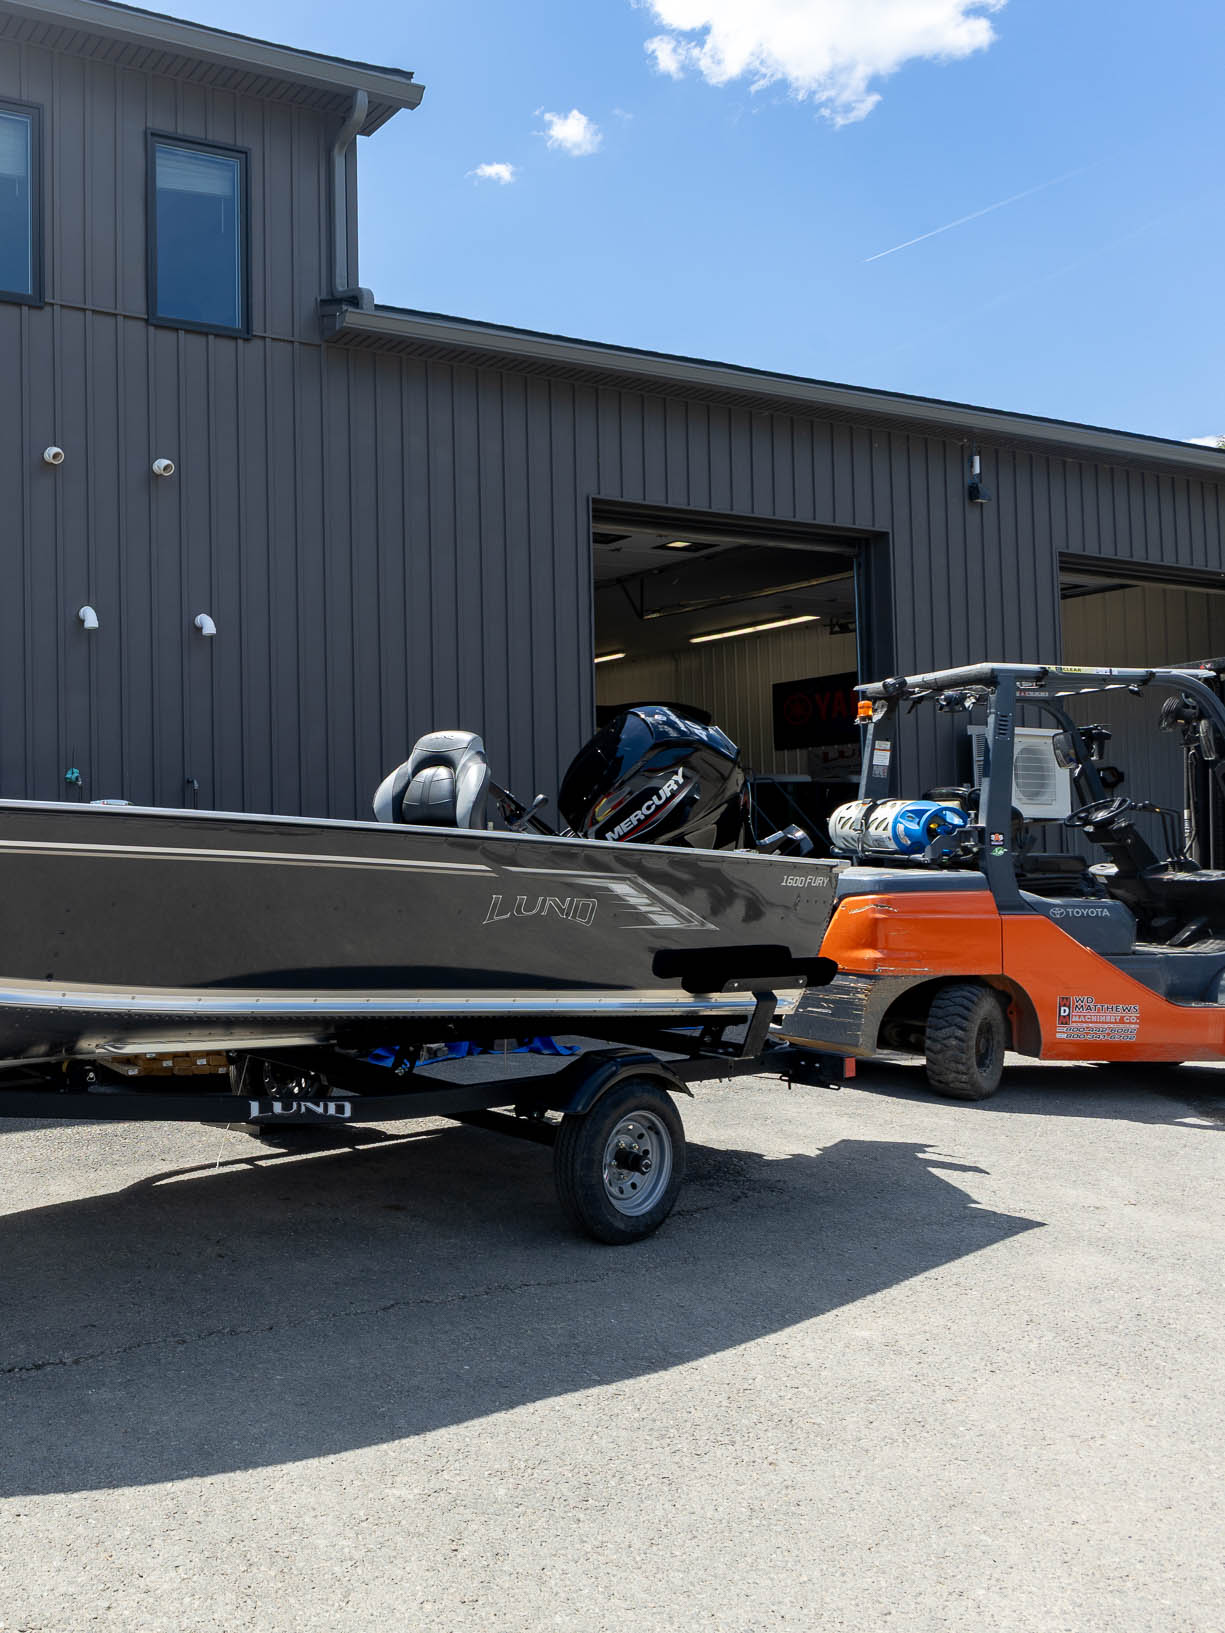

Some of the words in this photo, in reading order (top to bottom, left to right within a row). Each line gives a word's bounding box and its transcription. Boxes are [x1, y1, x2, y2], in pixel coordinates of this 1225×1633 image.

[605, 766, 686, 842] MERCURY
[781, 875, 806, 887] 1600
[805, 875, 829, 887] FURY
[482, 894, 598, 927] LUND
[1066, 908, 1111, 917] TOYOTA
[1074, 996, 1095, 1004] WD
[1073, 1004, 1139, 1013] MATTHEWS
[248, 1099, 352, 1120] LUND
